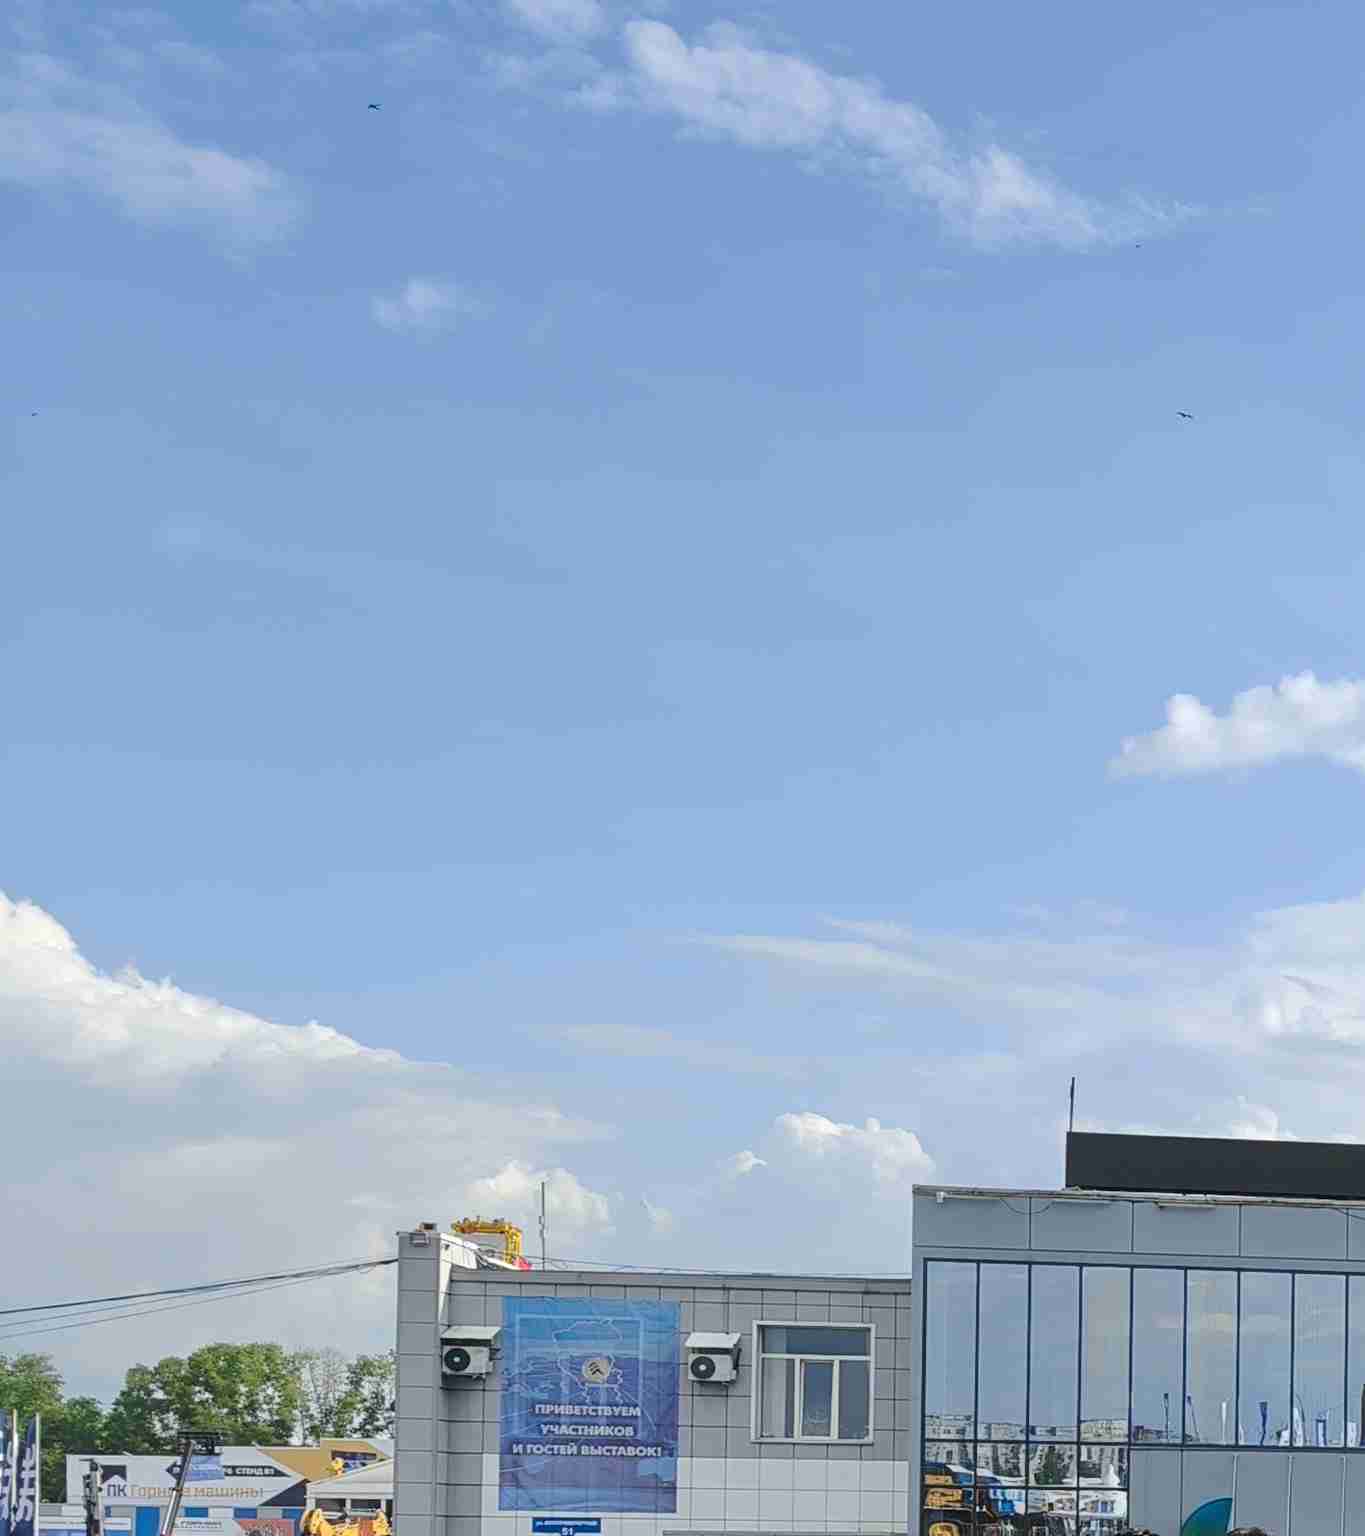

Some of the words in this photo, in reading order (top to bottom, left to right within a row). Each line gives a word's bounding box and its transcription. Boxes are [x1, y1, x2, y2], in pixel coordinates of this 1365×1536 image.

[535, 1404, 641, 1417] ПРИВЕТСТВУЕМ
[540, 1424, 635, 1437] УЧАСТНИКОВ
[512, 1444, 523, 1455] И
[526, 1442, 577, 1455] ГОСТЕЙ
[581, 1445, 662, 1457] ВЫСТАВОК!
[107, 1484, 128, 1497] ПК
